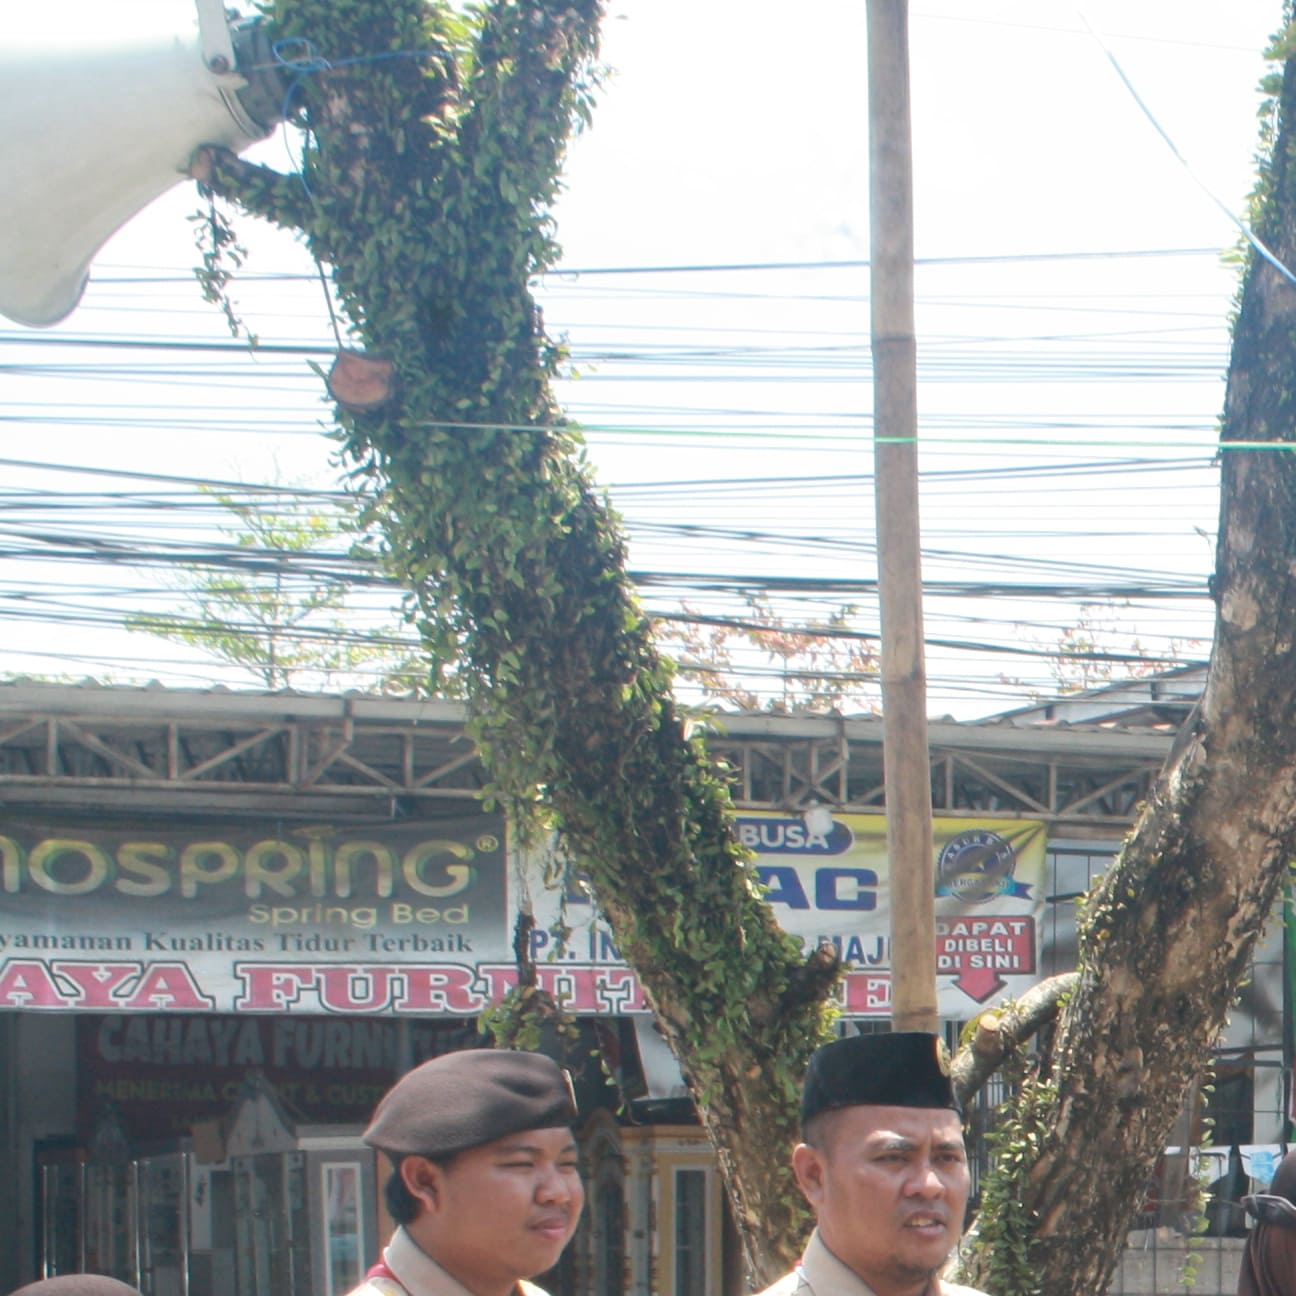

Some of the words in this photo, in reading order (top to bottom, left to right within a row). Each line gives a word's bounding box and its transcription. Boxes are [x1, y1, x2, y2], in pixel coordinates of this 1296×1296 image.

[739, 823, 829, 849] BUSA
[249, 903, 377, 929] Spring
[392, 903, 470, 924] Bed
[935, 922, 1027, 936] DAPAT
[144, 931, 265, 952] Kualitas
[276, 933, 356, 953] Tidur
[363, 932, 474, 953] Terbaik
[944, 938, 1014, 953] DIBELI
[937, 955, 961, 969] DI
[969, 955, 1020, 970] SINI
